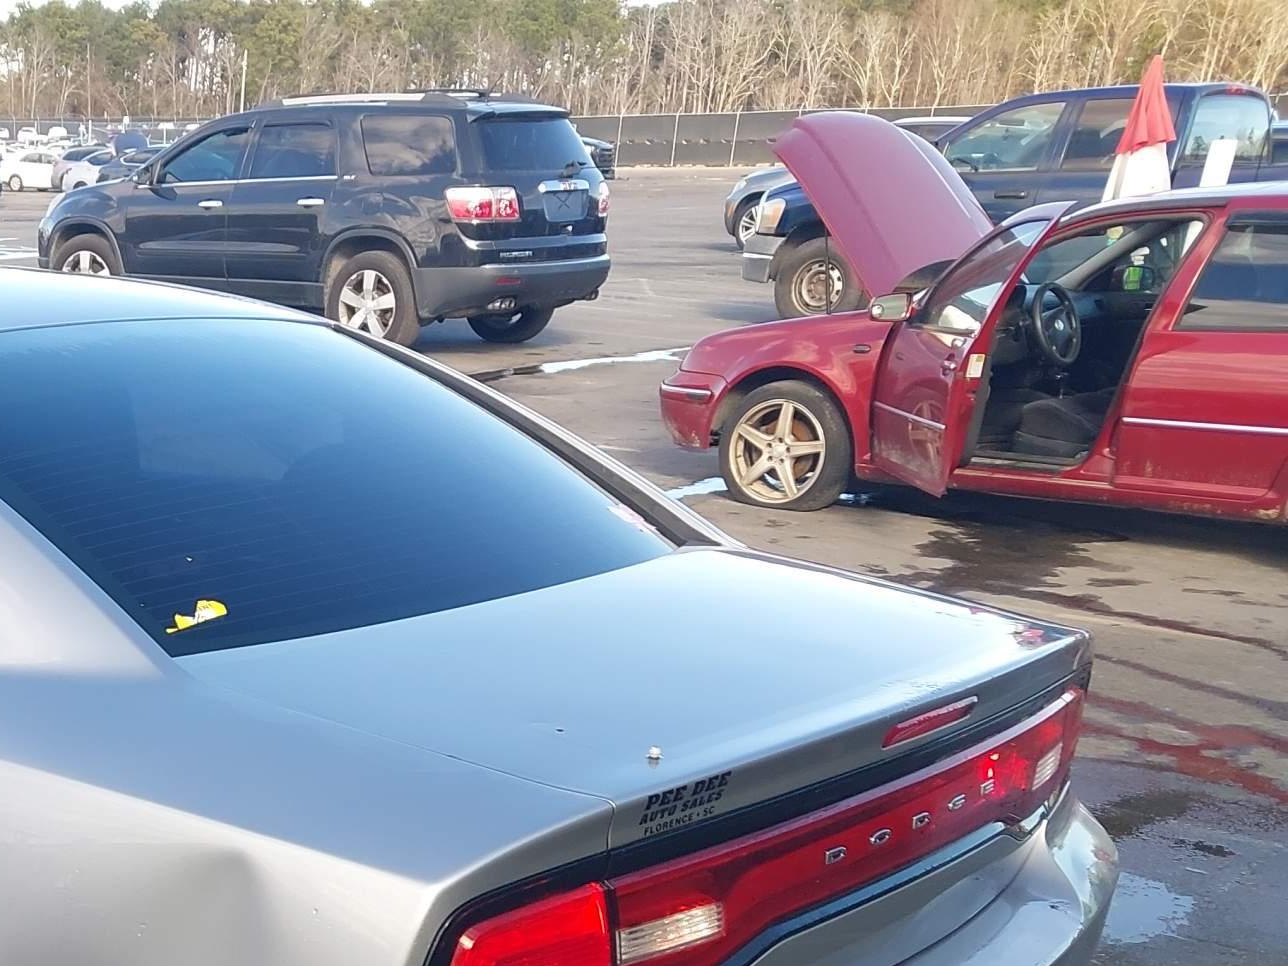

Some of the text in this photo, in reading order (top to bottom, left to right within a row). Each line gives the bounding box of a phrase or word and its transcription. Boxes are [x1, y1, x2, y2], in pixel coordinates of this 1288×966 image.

[639, 788, 725, 826] AUTO SALES
[644, 770, 732, 811] PEE DEE
[643, 812, 695, 836] FLORENCE
[703, 805, 716, 817] SC
[824, 778, 996, 865] DODGE
